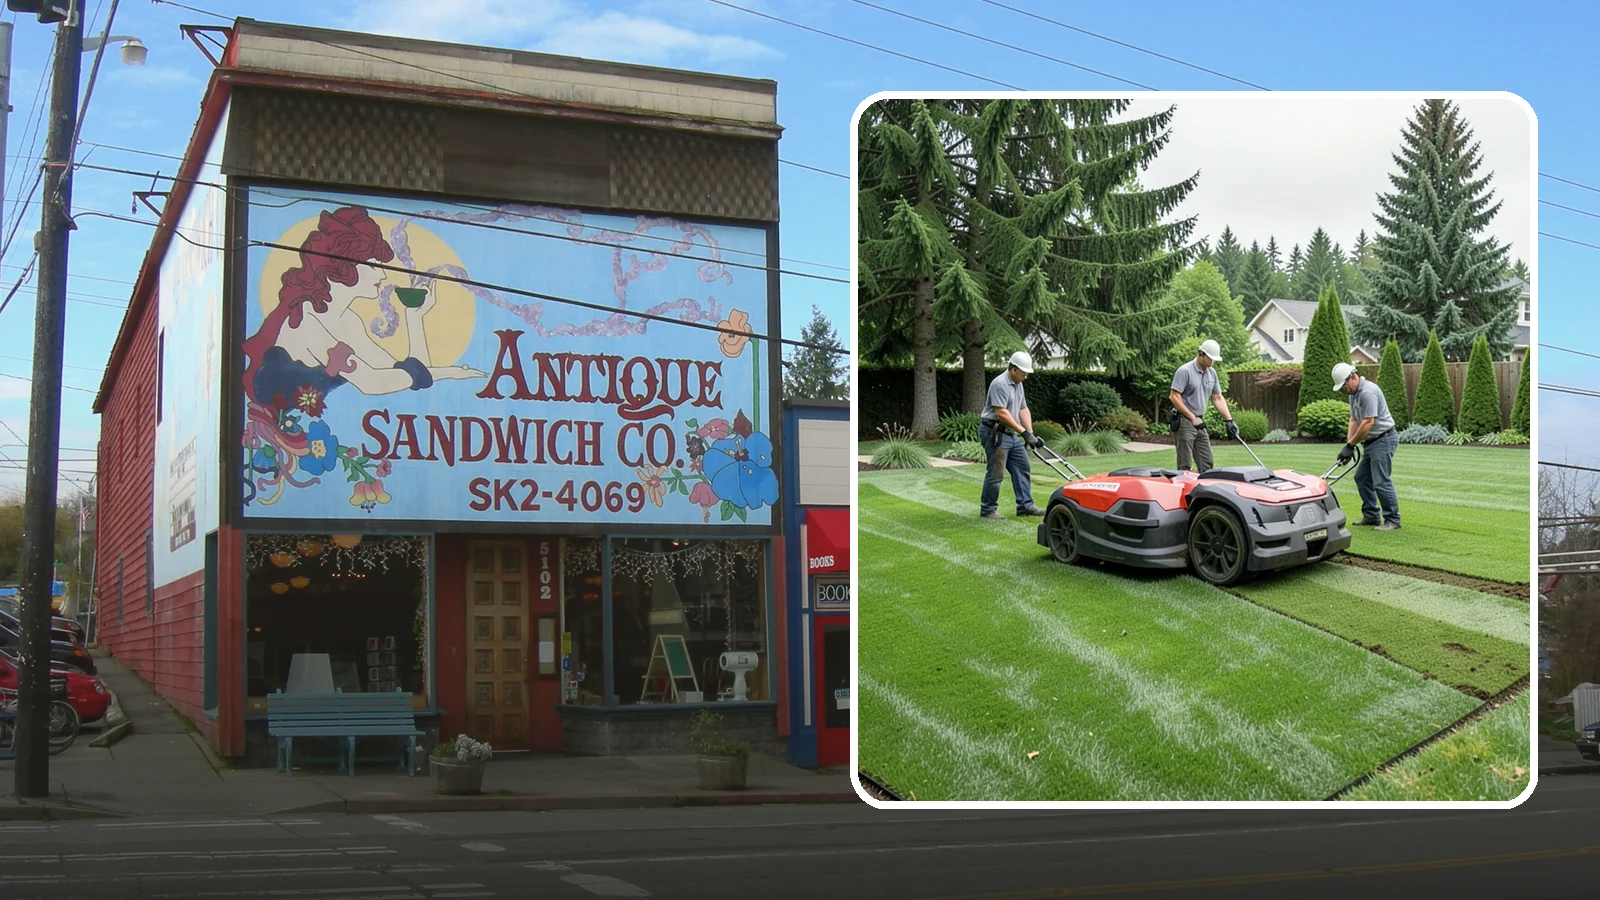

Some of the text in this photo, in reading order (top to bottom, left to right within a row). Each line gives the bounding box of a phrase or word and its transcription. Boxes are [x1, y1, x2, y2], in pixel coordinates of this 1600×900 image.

[476, 329, 723, 420] ANTIQUE
[361, 409, 685, 468] SANDWICH CO.
[468, 478, 646, 512] SK2-4069
[540, 541, 551, 600] 5102
[809, 555, 835, 569] BOOKS
